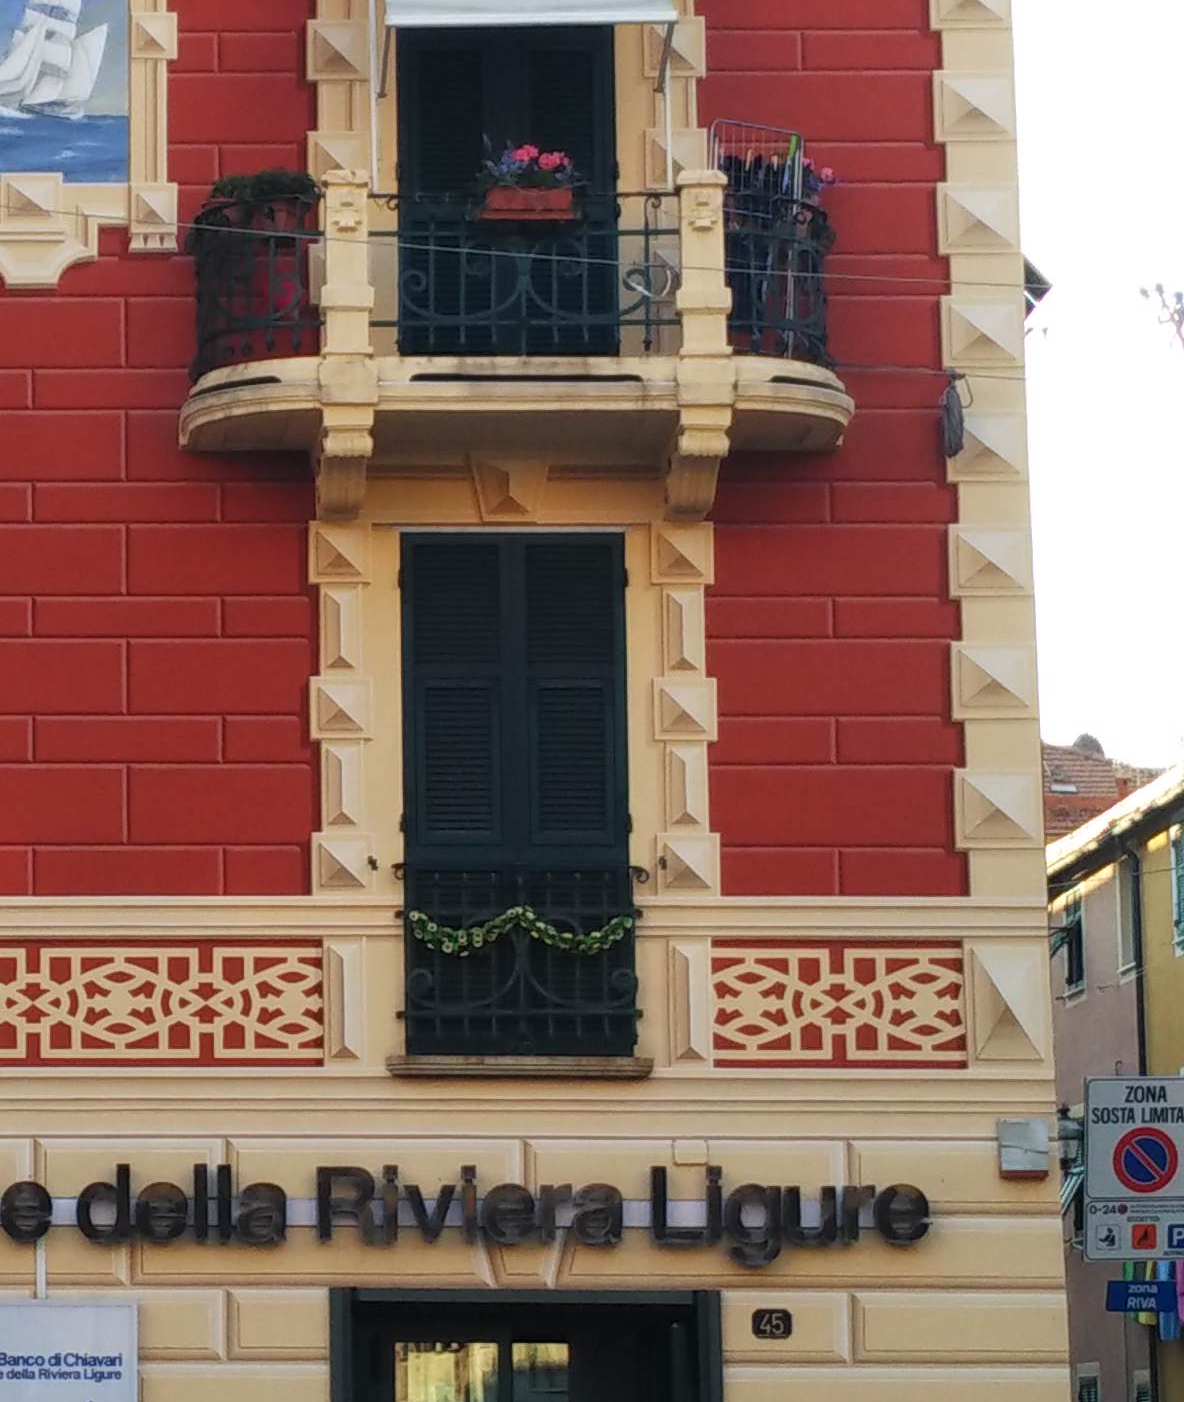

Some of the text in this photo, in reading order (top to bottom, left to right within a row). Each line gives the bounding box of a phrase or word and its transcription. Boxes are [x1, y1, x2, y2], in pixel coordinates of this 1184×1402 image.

[1124, 1085, 1167, 1104] ZONA
[1091, 1107, 1136, 1124] SOSTA
[0, 1180, 53, 1244] e
[76, 1163, 287, 1245] della
[316, 1164, 624, 1246] Riviera
[650, 1165, 930, 1268] Ligure
[1089, 1204, 1117, 1215] 0-24
[1127, 1284, 1159, 1294] zona
[1127, 1296, 1157, 1310] RIVA
[759, 1313, 785, 1335] 45
[47, 1352, 62, 1367] di
[63, 1352, 123, 1367] Chiavari
[6, 1368, 36, 1380] della
[38, 1368, 82, 1380] Riviera
[84, 1368, 122, 1383] Ligure
